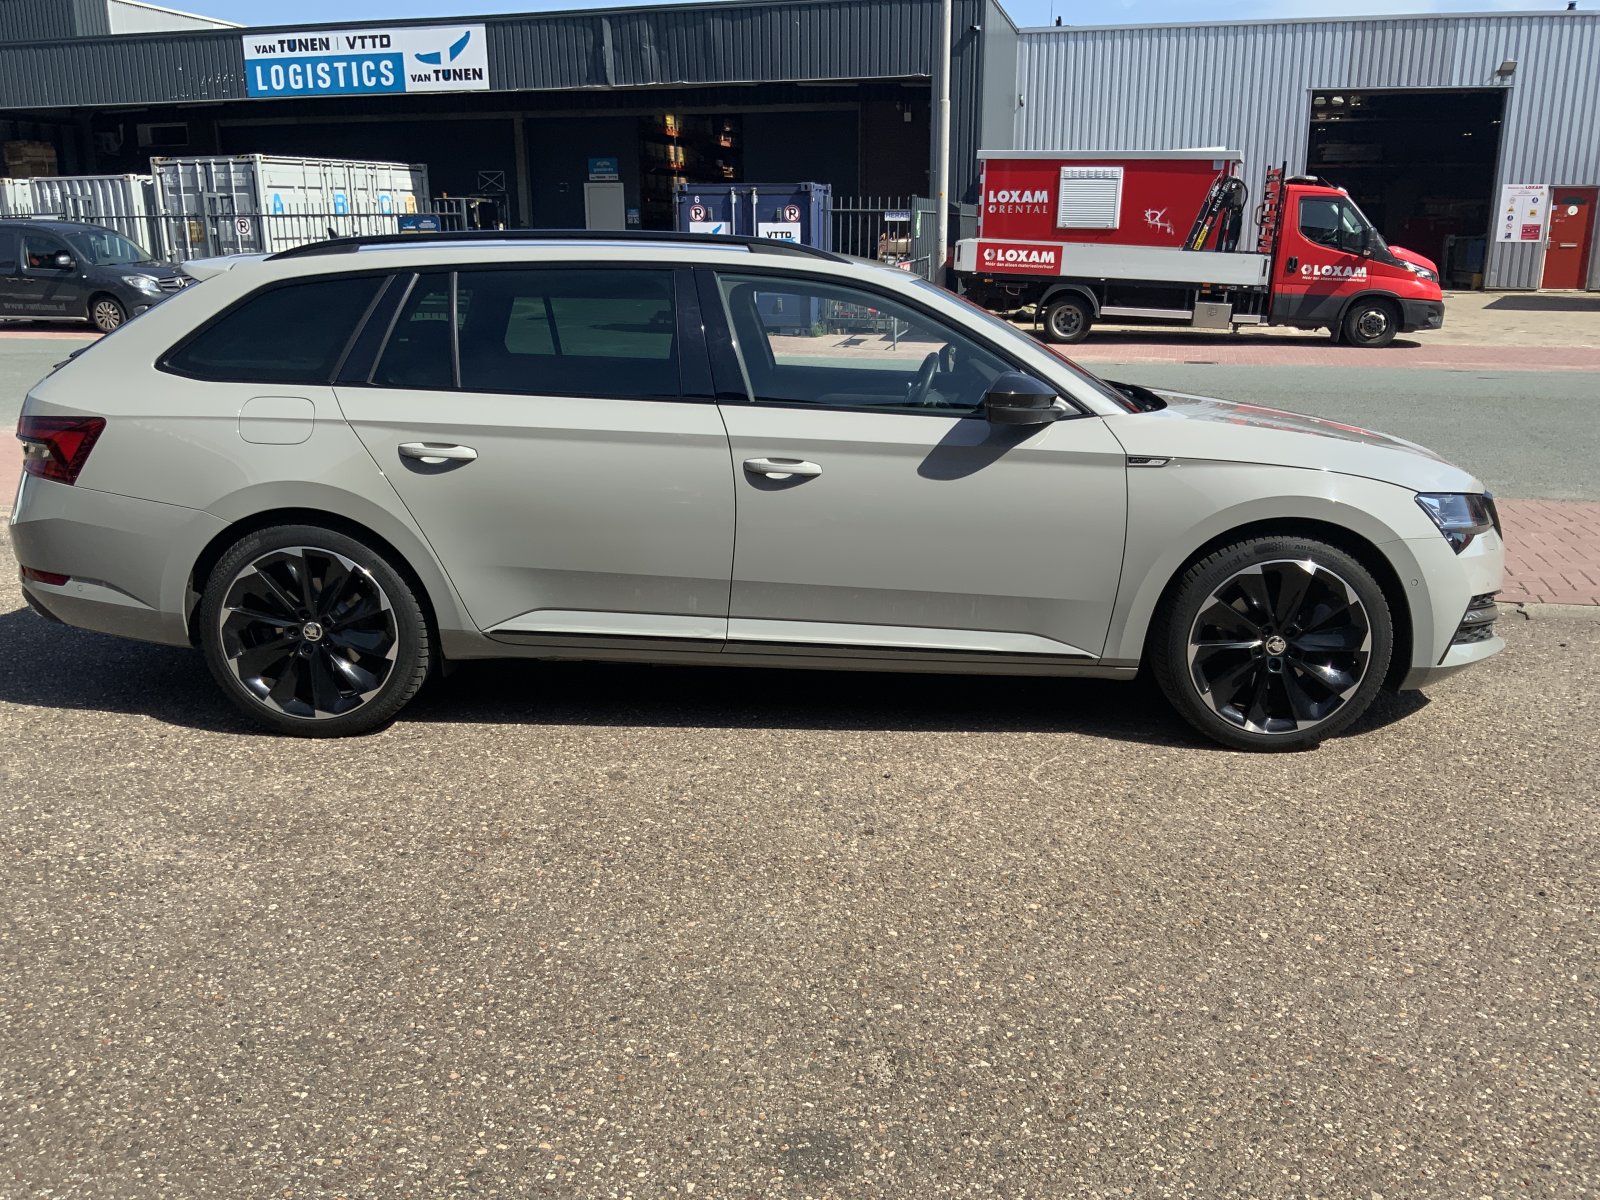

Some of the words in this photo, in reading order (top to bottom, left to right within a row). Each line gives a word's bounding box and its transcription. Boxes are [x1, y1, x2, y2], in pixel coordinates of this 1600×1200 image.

[254, 44, 276, 54] VAN
[277, 37, 331, 52] TUNEN
[345, 34, 391, 50] VTTD
[255, 60, 395, 91] LOGISTICS
[410, 73, 431, 83] VAN
[433, 67, 483, 82] TUNEN
[694, 196, 700, 204] 6
[988, 190, 1049, 203] LOXAM
[999, 204, 1048, 214] RENTAL
[766, 231, 792, 239] VTTD
[996, 249, 1056, 264] LOXAM
[1313, 264, 1367, 278] LOXAM
